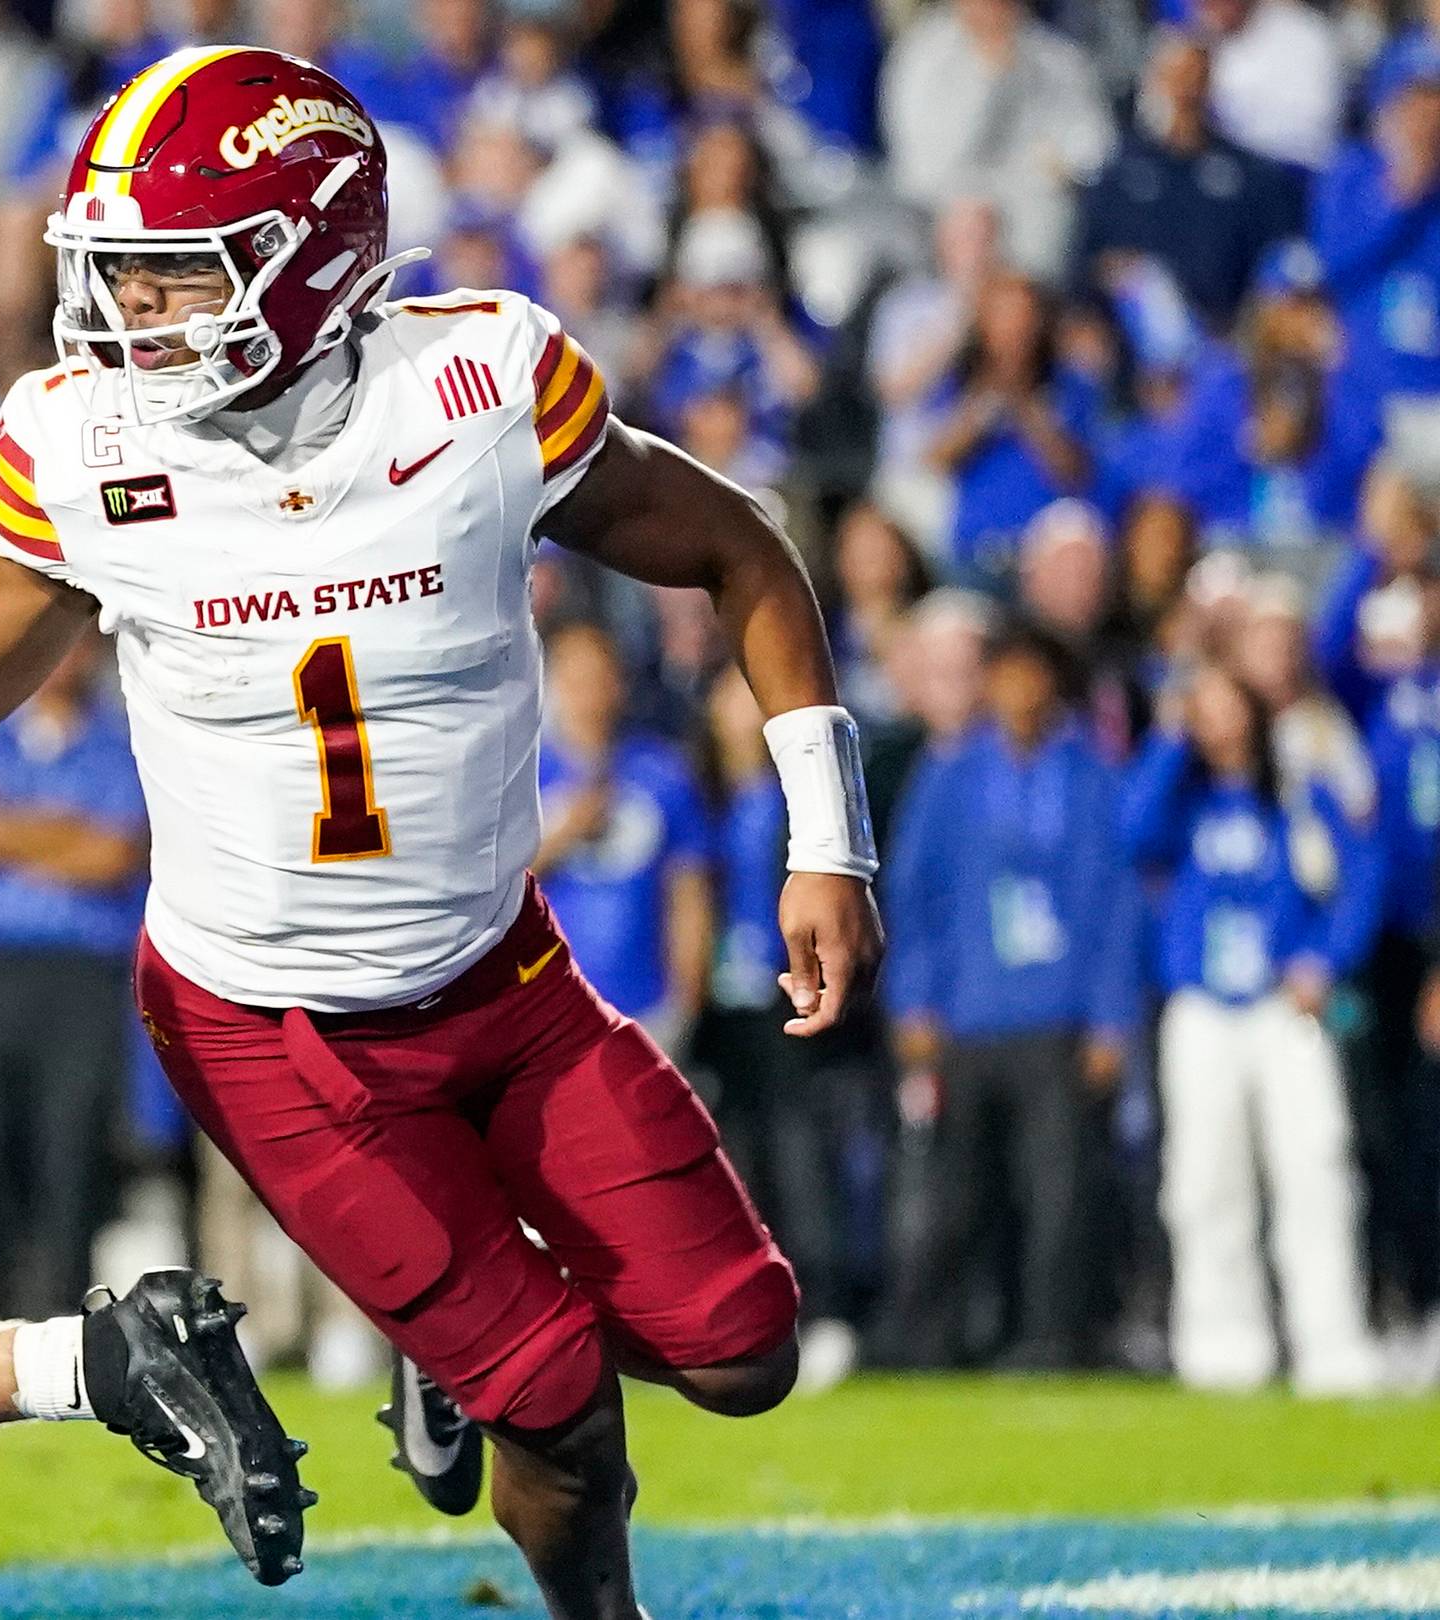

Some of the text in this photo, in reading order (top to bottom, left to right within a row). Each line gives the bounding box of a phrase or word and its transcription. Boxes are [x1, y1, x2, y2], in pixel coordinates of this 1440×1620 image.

[81, 414, 124, 468] C
[193, 564, 444, 629] IOWA STATE
[292, 634, 393, 864] 1
